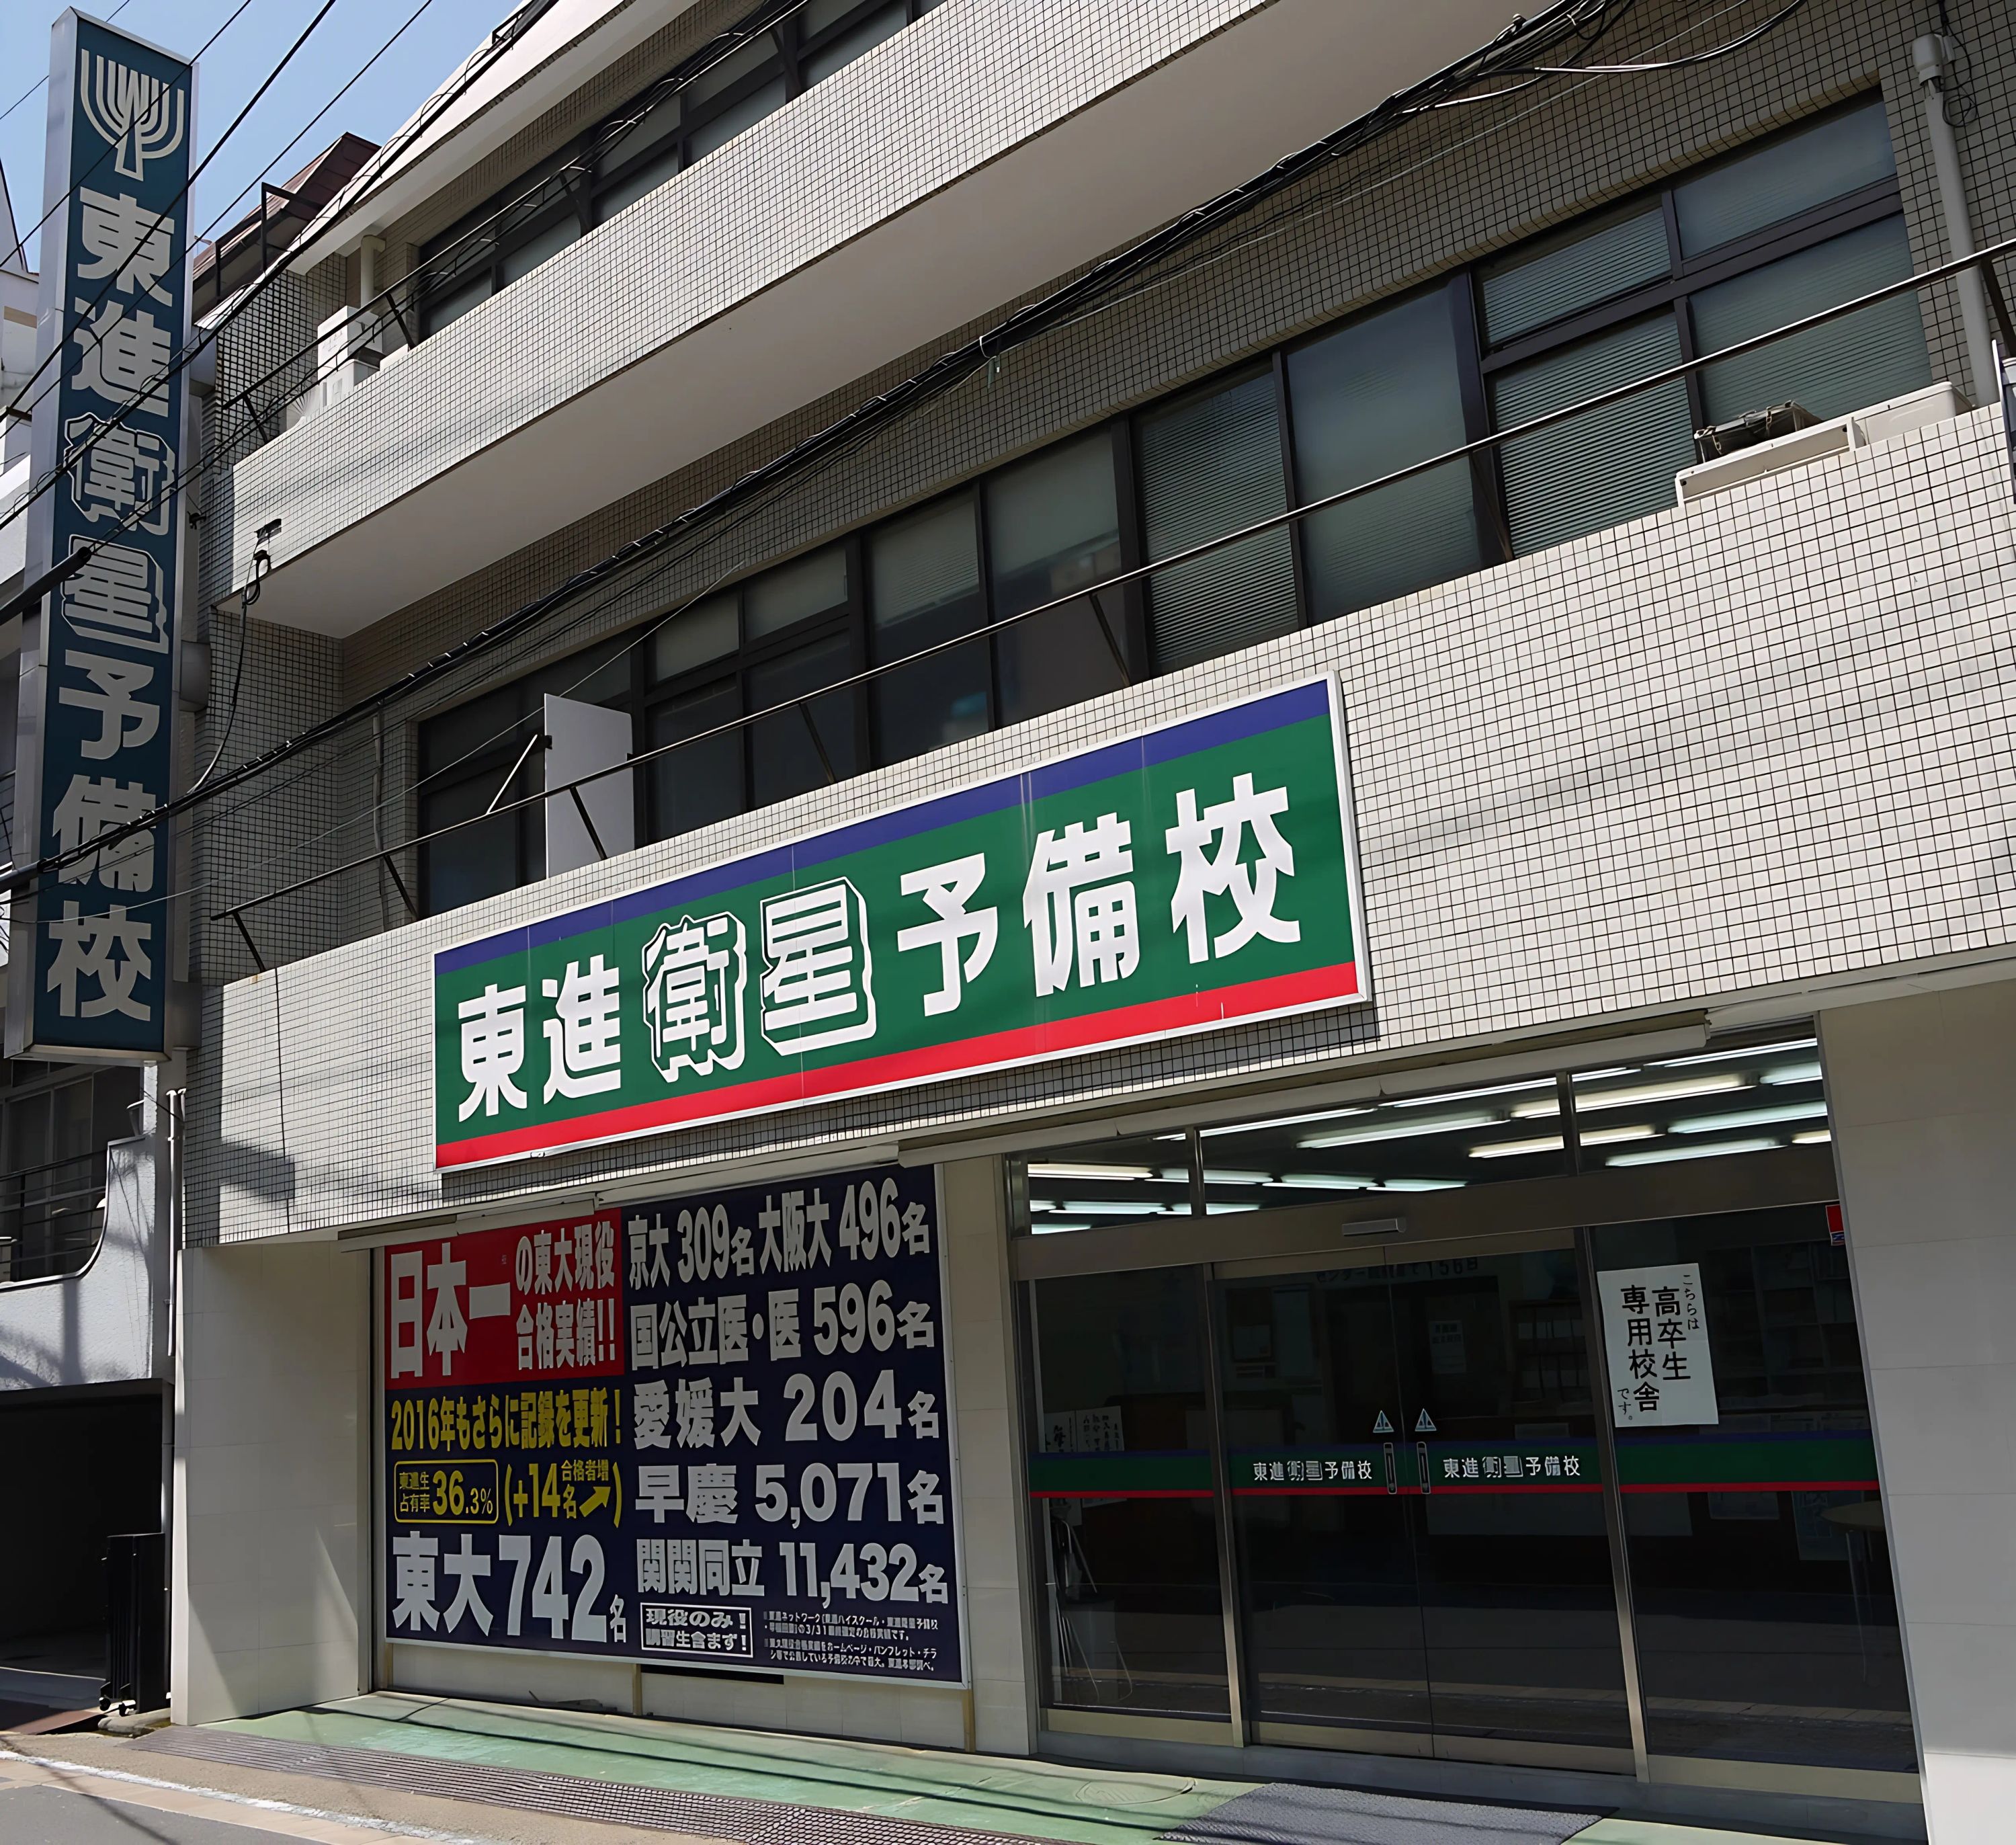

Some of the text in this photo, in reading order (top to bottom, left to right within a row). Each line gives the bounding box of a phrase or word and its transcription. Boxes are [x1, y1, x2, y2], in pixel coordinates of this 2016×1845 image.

[46, 192, 175, 1022] 東進衛星予備校
[457, 772, 1302, 1122] 東進衛星予備校
[515, 1222, 615, 1295] の東大現役
[628, 1177, 931, 1290] 京大 309名 大阪大 496名
[390, 1241, 511, 1379] 日本一
[813, 1279, 935, 1356] 596名
[1651, 1285, 1691, 1381] 高卒生
[1683, 1274, 1700, 1330] こちらは
[1620, 1284, 1660, 1412] 専用校舎
[634, 1369, 940, 1450] 愛媛大 204名
[635, 1462, 945, 1529] 早慶 5,071名
[1443, 1455, 1581, 1478] 東進予備校
[636, 1538, 950, 1610] 関関同立 11,432名
